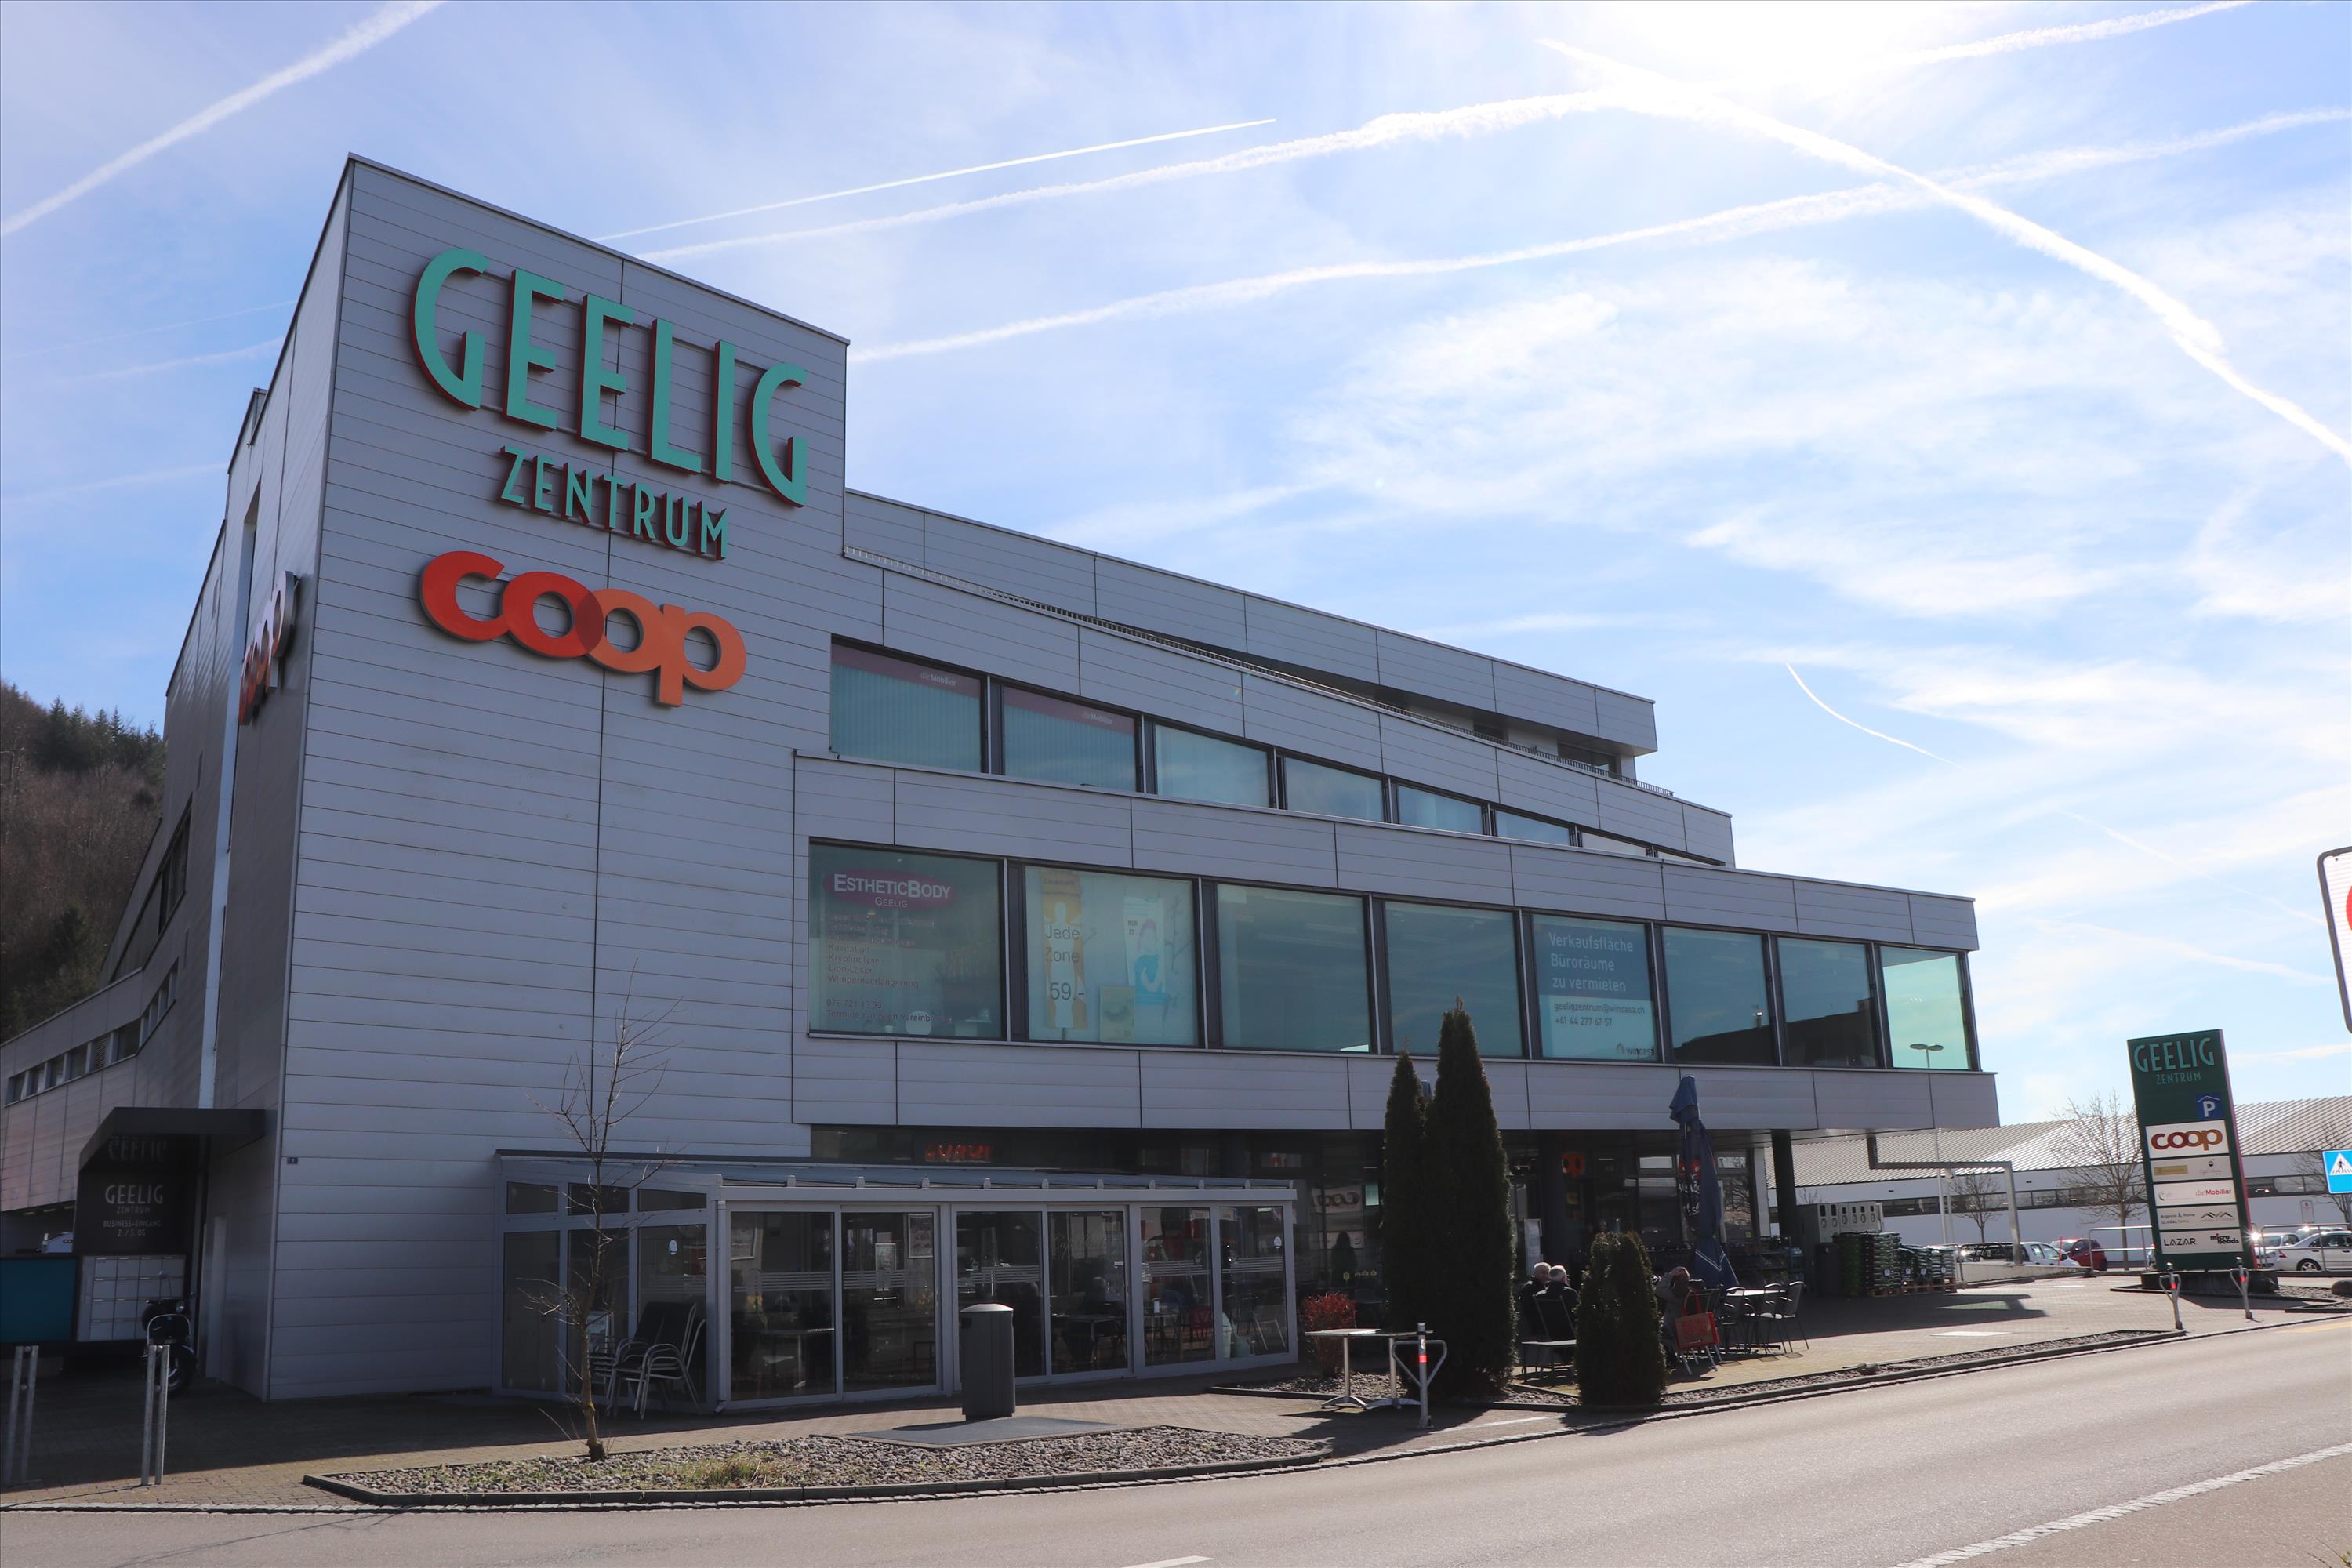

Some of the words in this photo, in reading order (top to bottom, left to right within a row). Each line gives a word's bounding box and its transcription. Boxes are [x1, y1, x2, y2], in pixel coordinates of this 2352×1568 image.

[410, 248, 809, 508] GEELIG
[499, 445, 730, 561] ZENTRUM
[419, 550, 747, 707] coop
[931, 673, 956, 687] Mobiliar
[1045, 925, 1080, 940] Jede
[1549, 931, 1634, 953] Verkaufsfläche
[1045, 946, 1080, 962] Zone
[1550, 953, 1615, 971] Büroräume
[1049, 982, 1085, 1002] 59.-
[1552, 978, 1566, 989] zu
[1569, 977, 1627, 992] vermieten
[2133, 1036, 2215, 1073] GEELIG
[2155, 1072, 2201, 1086] ZENTRUM
[2151, 1129, 2223, 1151] coop
[105, 1185, 163, 1204] GEELIG
[2164, 1238, 2197, 1247] LAZAR
